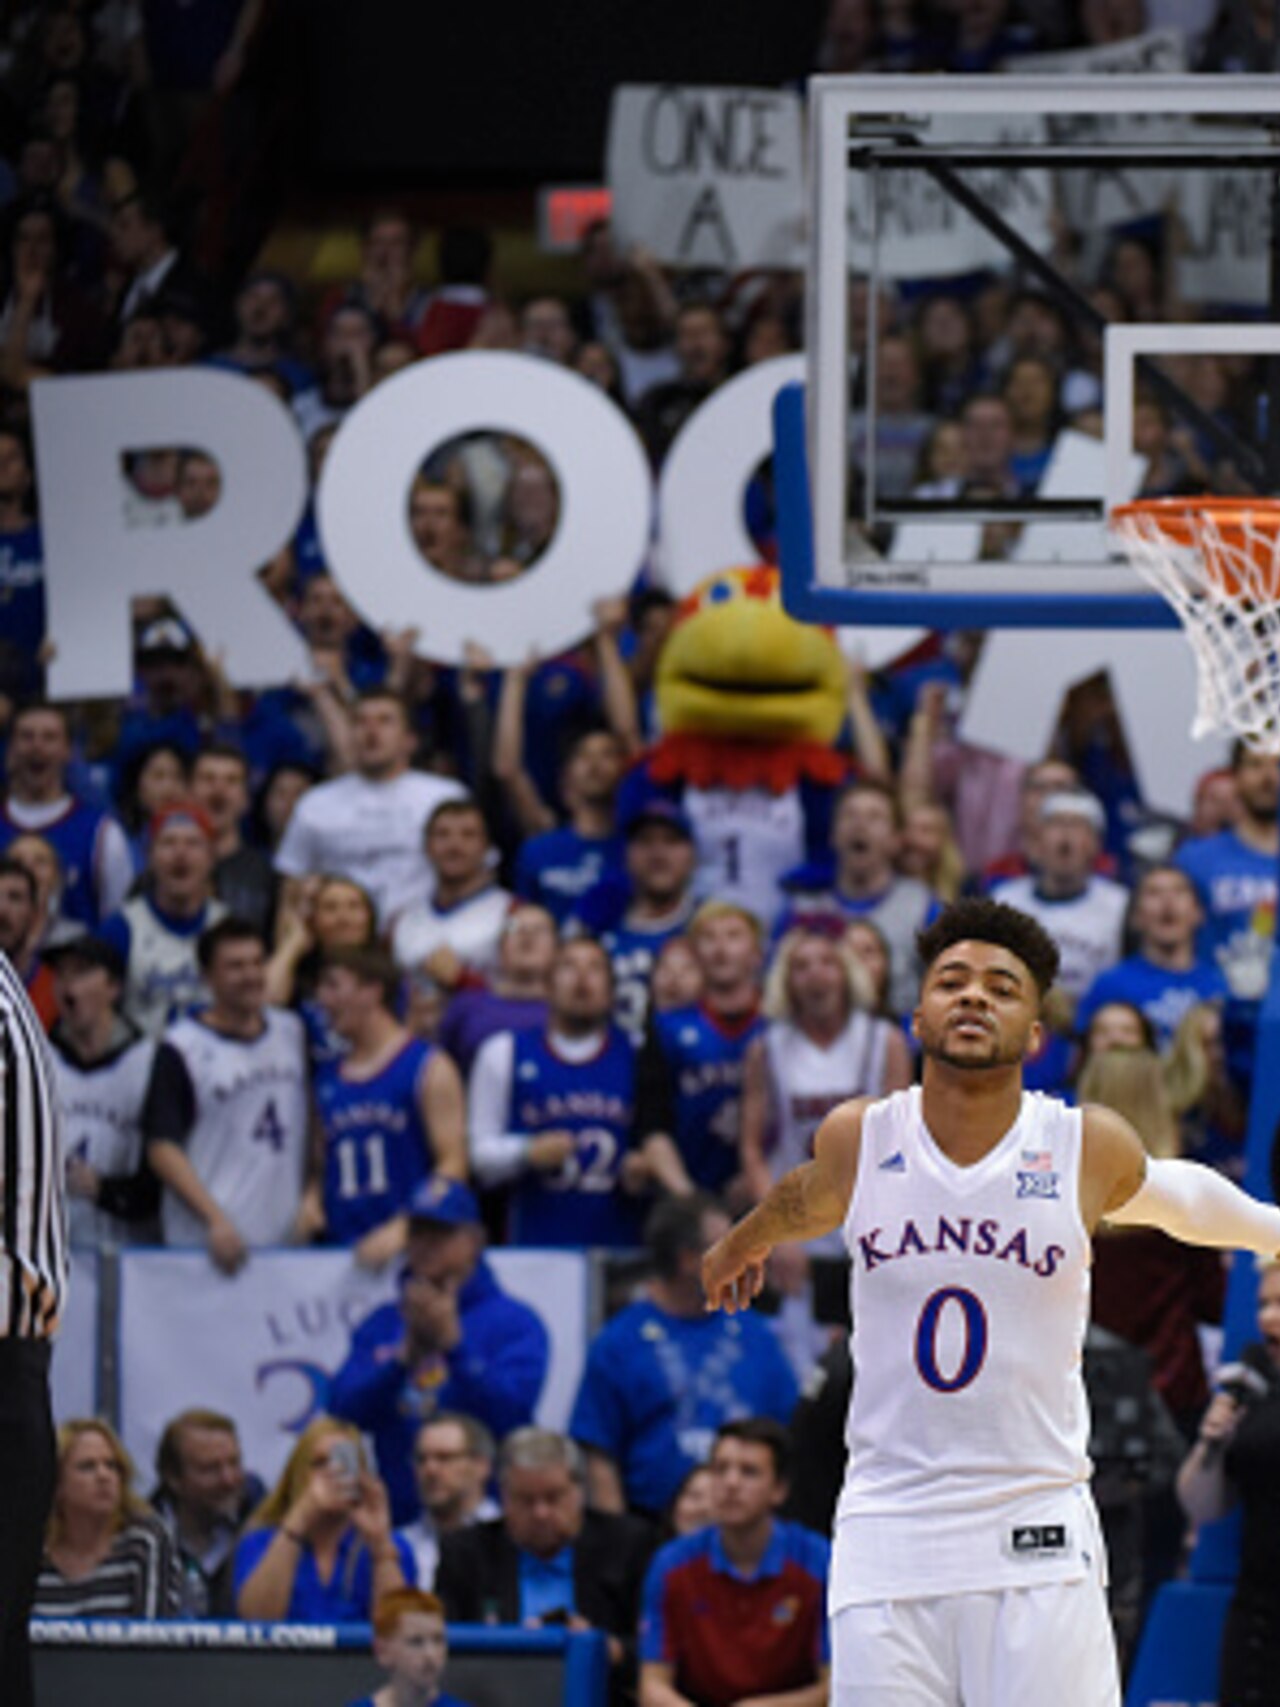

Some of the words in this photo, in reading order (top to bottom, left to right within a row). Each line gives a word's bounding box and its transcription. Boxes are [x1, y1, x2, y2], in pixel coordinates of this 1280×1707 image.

[676, 187, 738, 262] A
[251, 1097, 284, 1152] 4
[328, 1132, 388, 1198] 11
[858, 1214, 1066, 1278] KANSAS
[913, 1283, 989, 1395] 0
